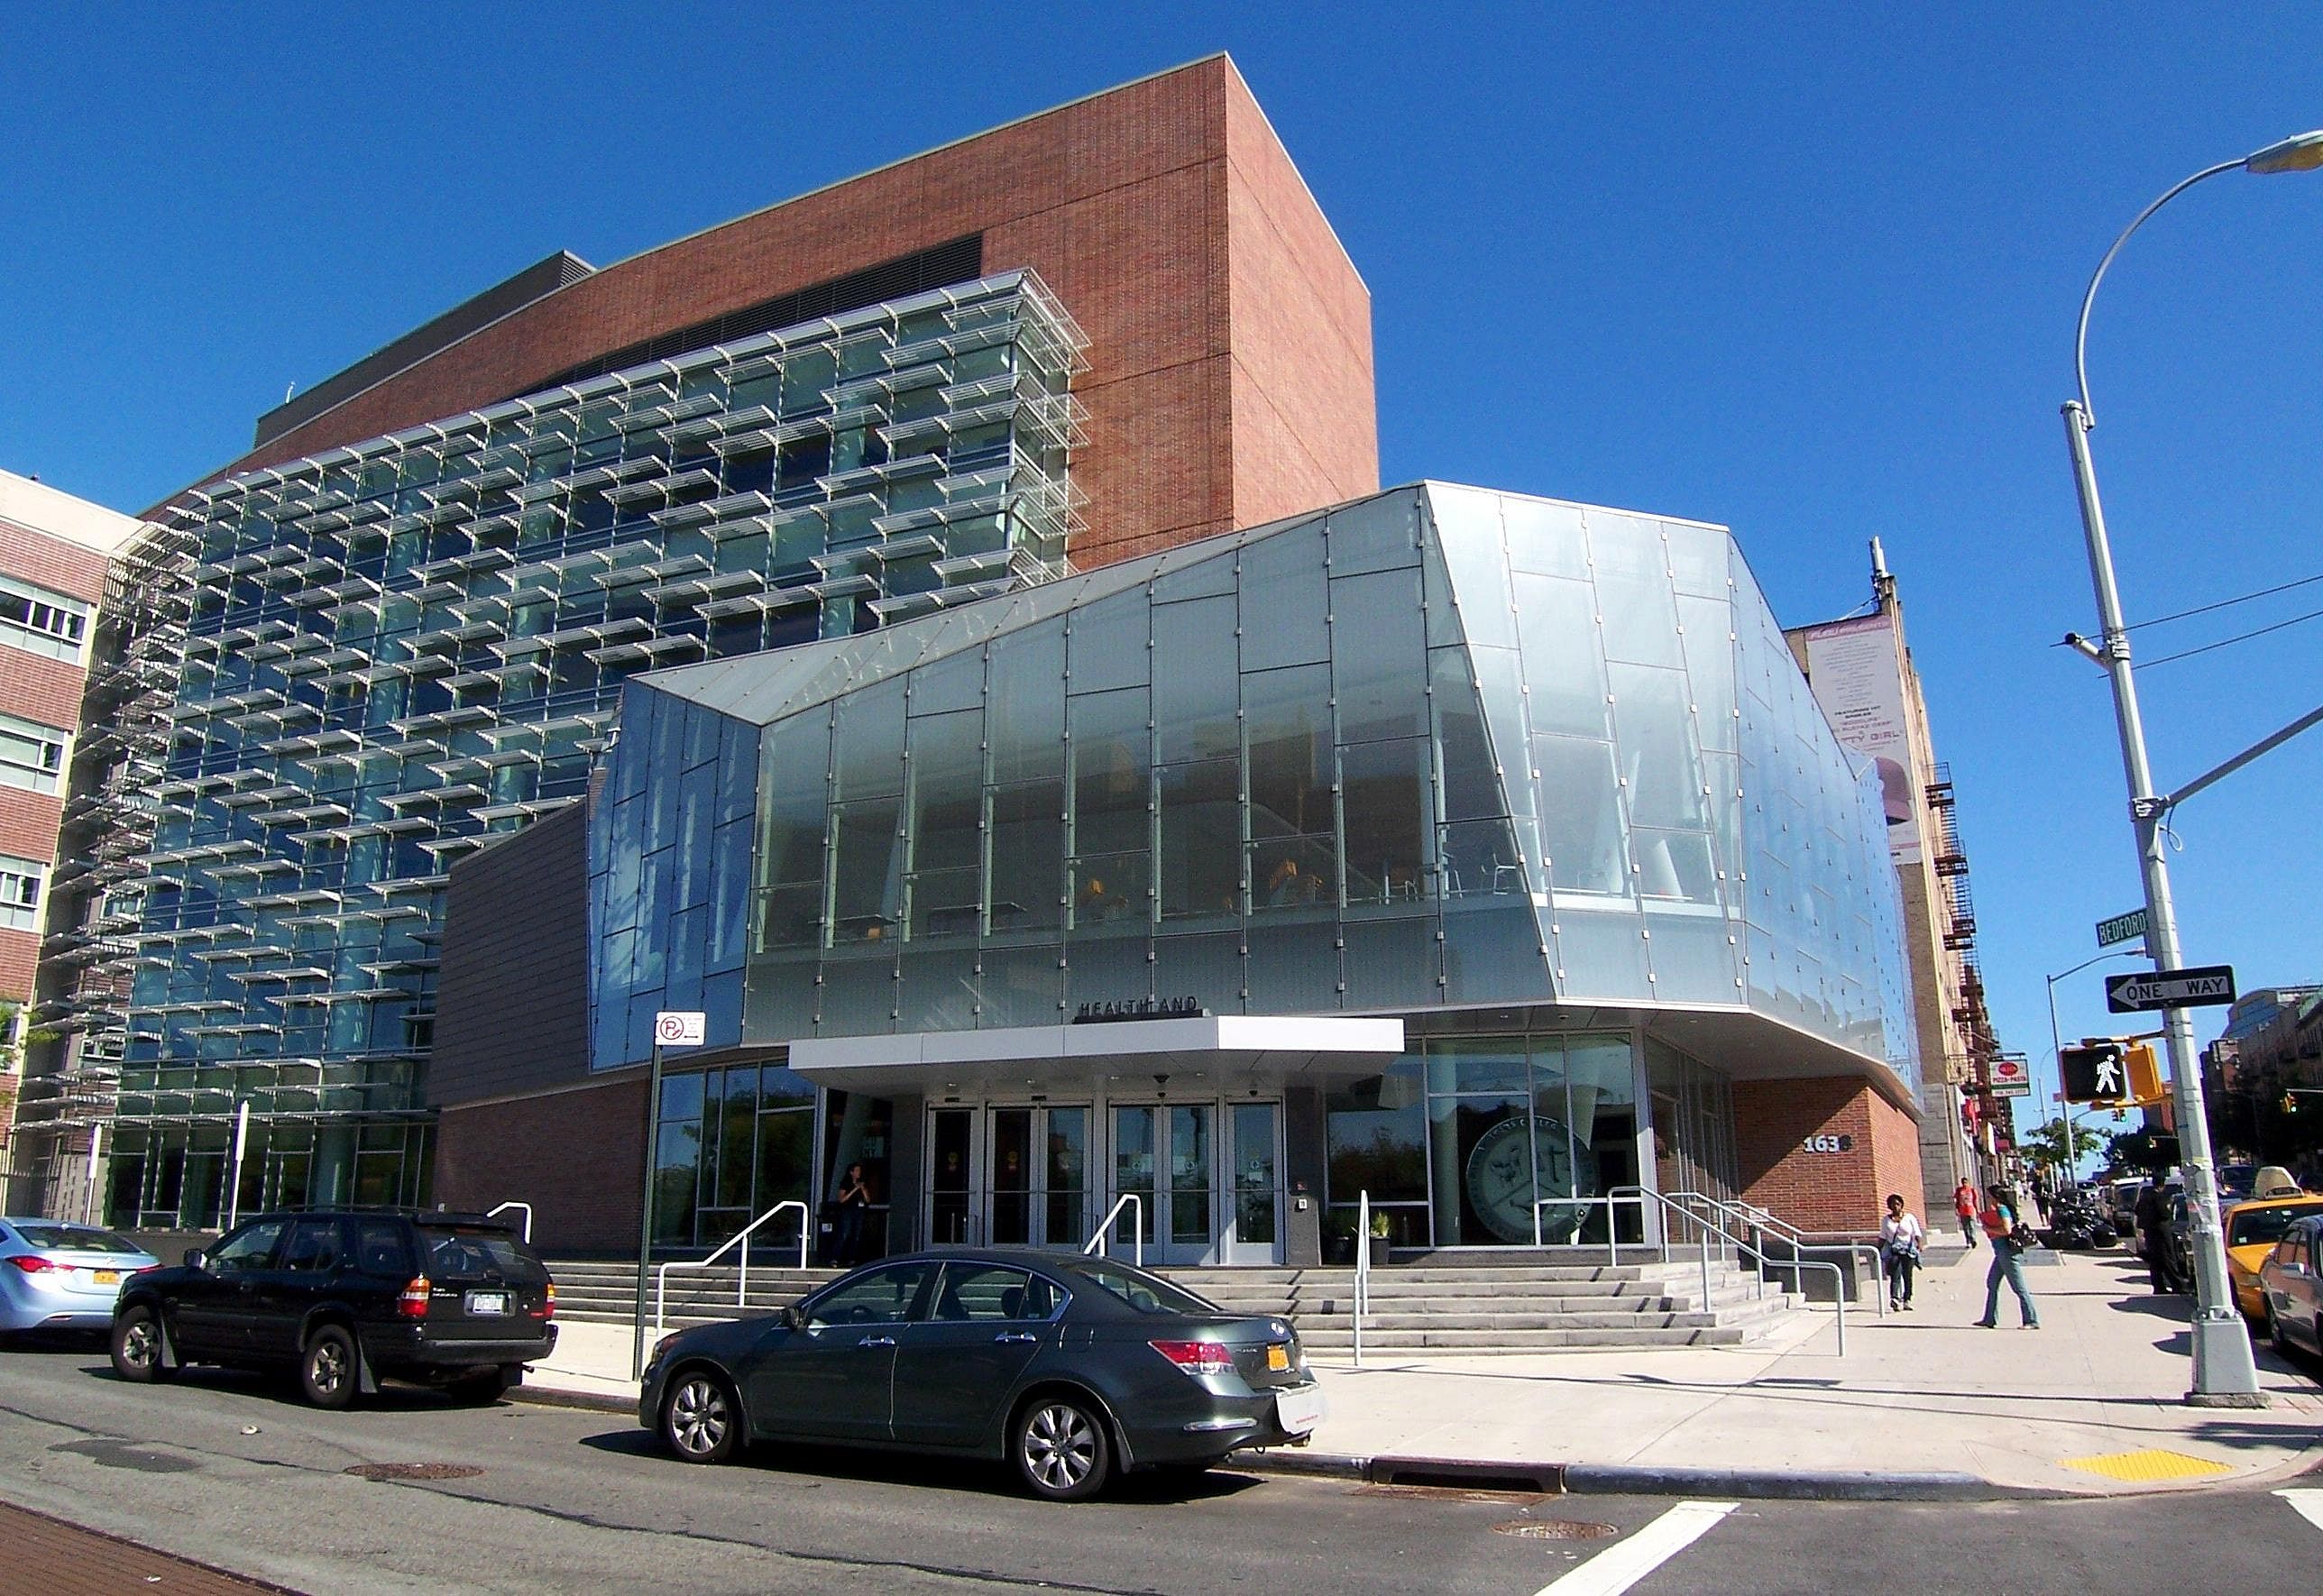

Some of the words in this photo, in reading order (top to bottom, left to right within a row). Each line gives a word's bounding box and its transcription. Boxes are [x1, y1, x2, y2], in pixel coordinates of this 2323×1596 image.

[2098, 913, 2147, 945] BEDFORD
[2126, 983, 2163, 1001] ONE
[2186, 977, 2225, 995] WAY
